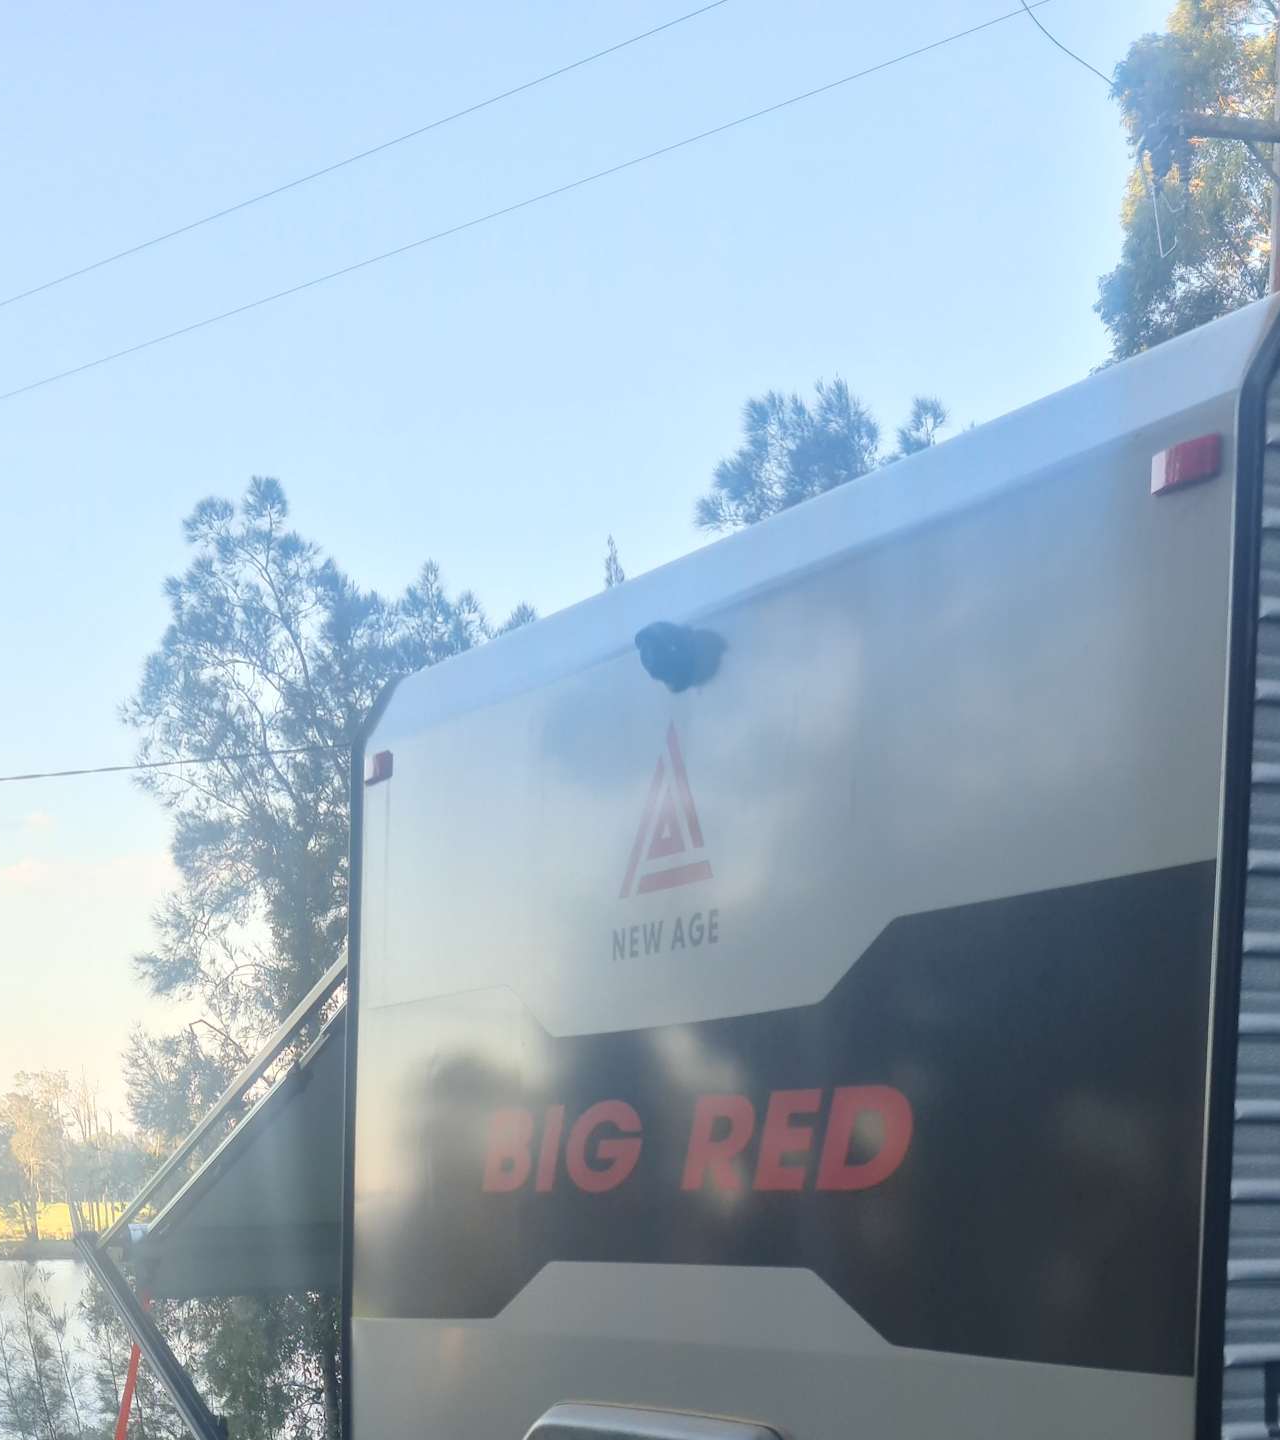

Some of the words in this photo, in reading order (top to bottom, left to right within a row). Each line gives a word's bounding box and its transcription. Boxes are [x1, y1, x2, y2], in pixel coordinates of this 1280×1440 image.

[612, 919, 664, 963] NEW
[671, 908, 721, 950] AGE
[481, 1098, 644, 1195] BIG
[680, 1083, 916, 1193] RED
